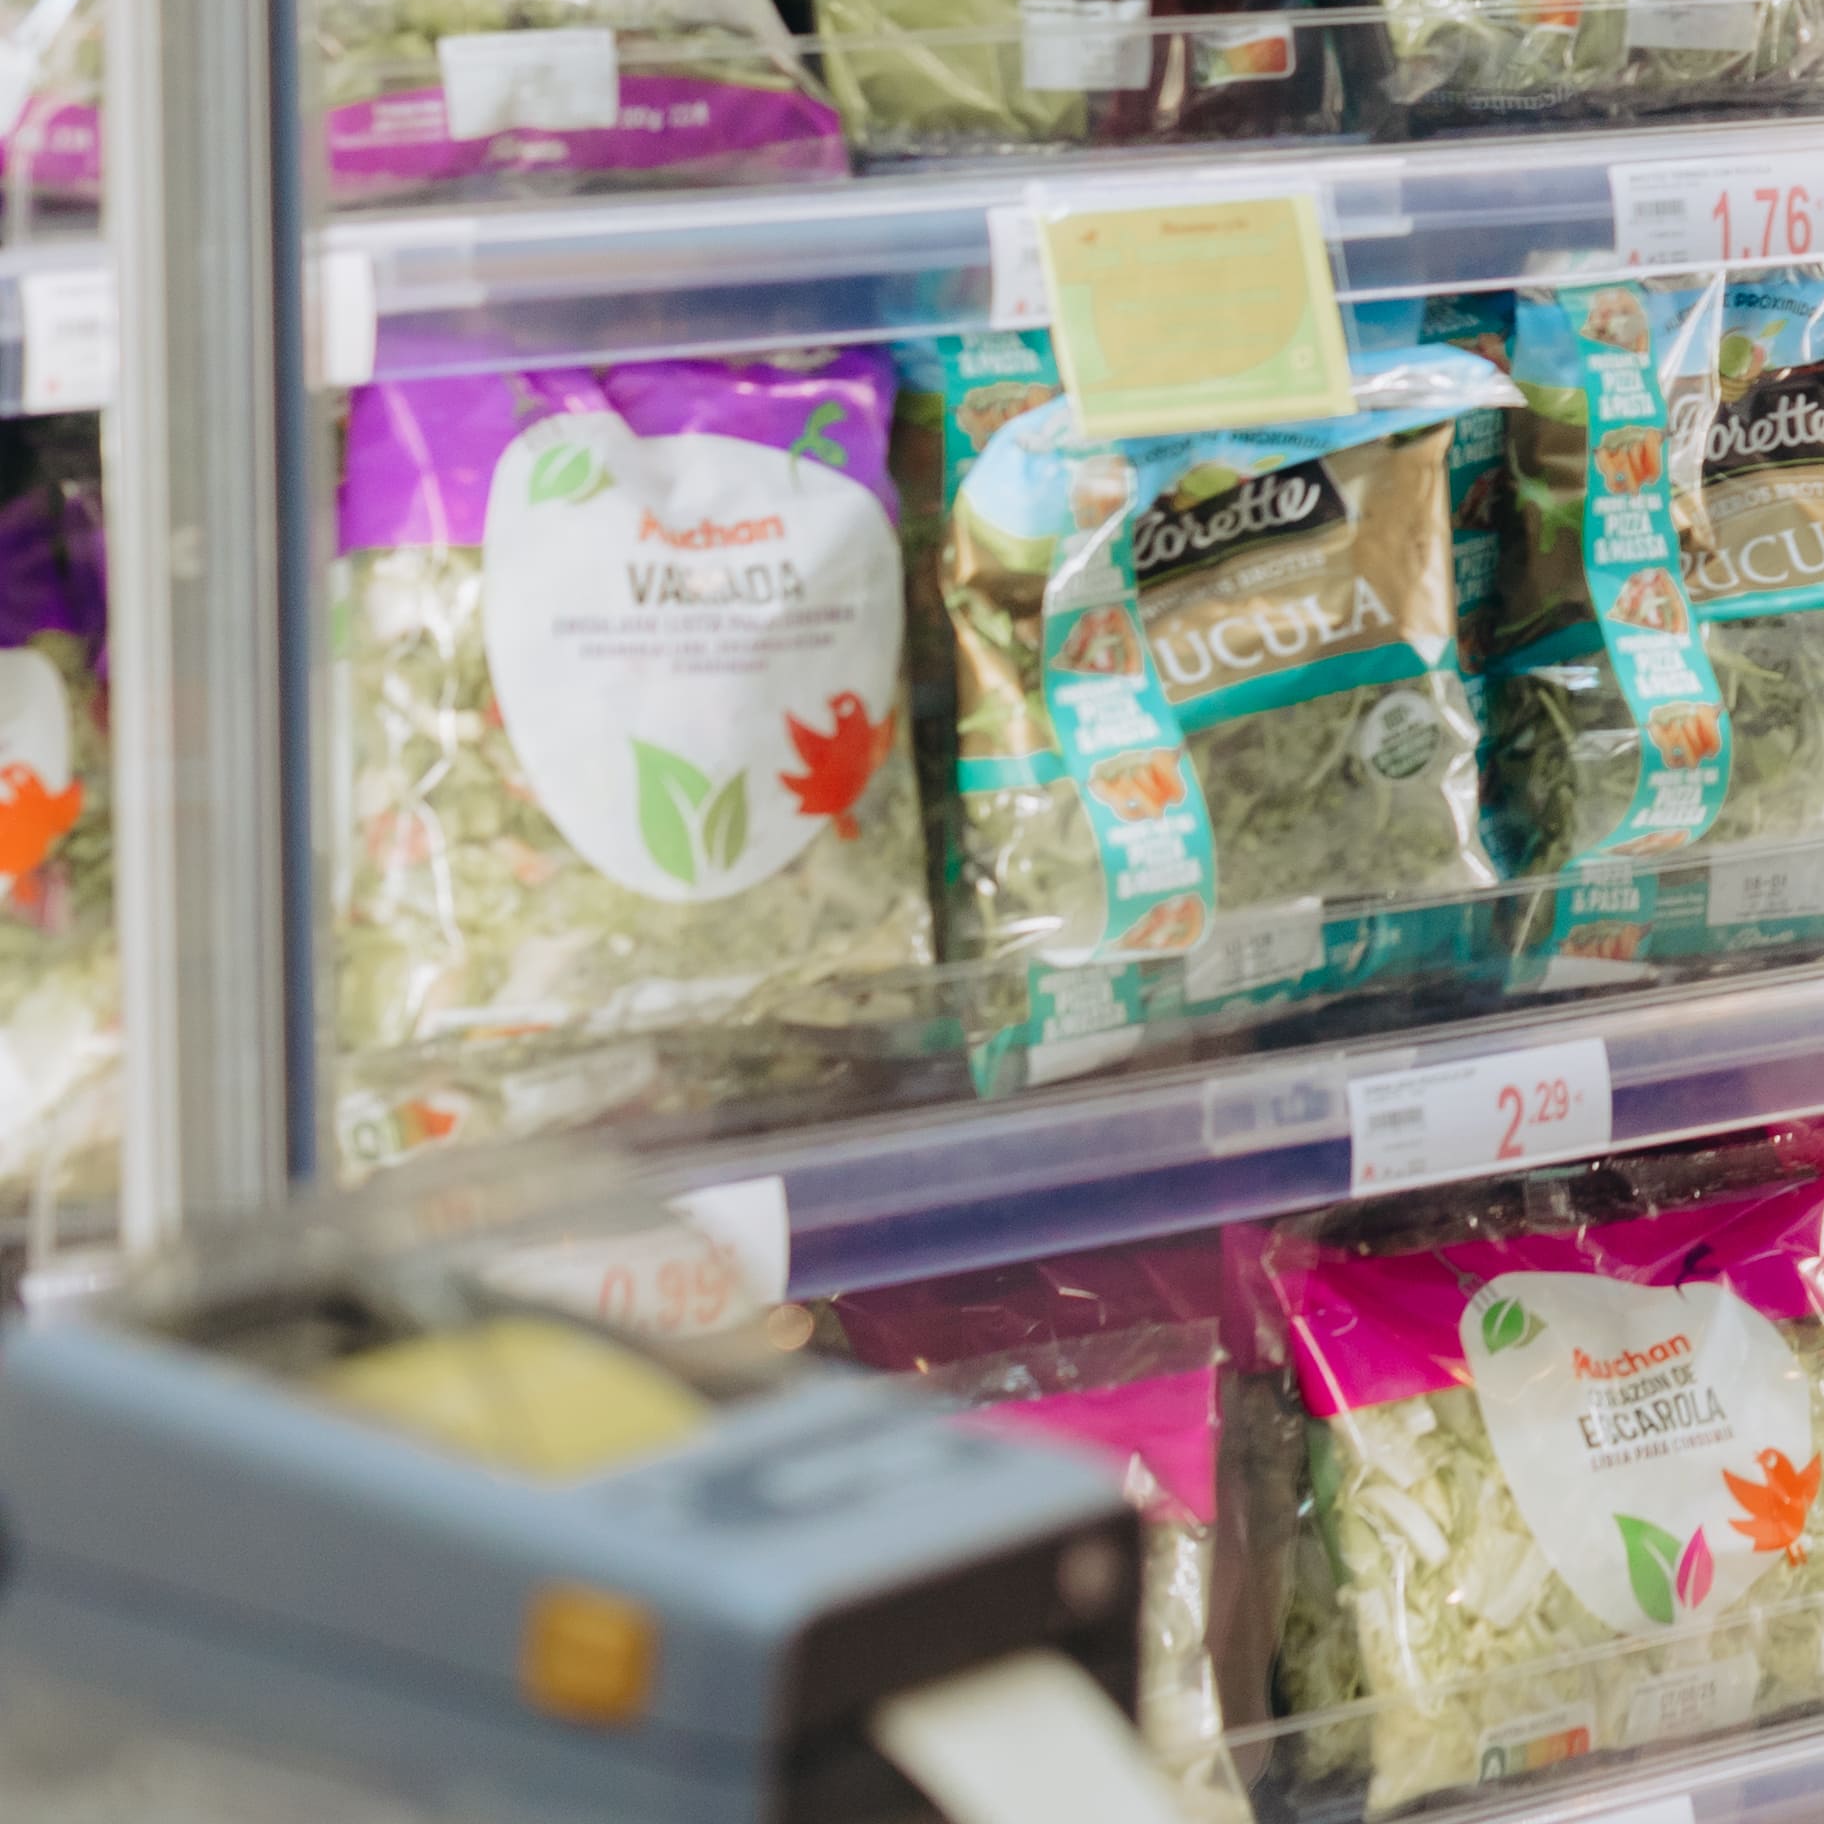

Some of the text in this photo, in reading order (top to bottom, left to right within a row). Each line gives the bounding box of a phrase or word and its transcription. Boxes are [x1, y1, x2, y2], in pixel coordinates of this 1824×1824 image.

[1711, 185, 1813, 262] 1.76
[638, 508, 786, 550] Auchan
[1134, 475, 1323, 570] lorette
[1154, 574, 1395, 687] ÚCULA
[1497, 1078, 1570, 1159] 2.29
[1571, 1331, 1693, 1382] Auchan
[1577, 1393, 1728, 1450] ESCAROLA
